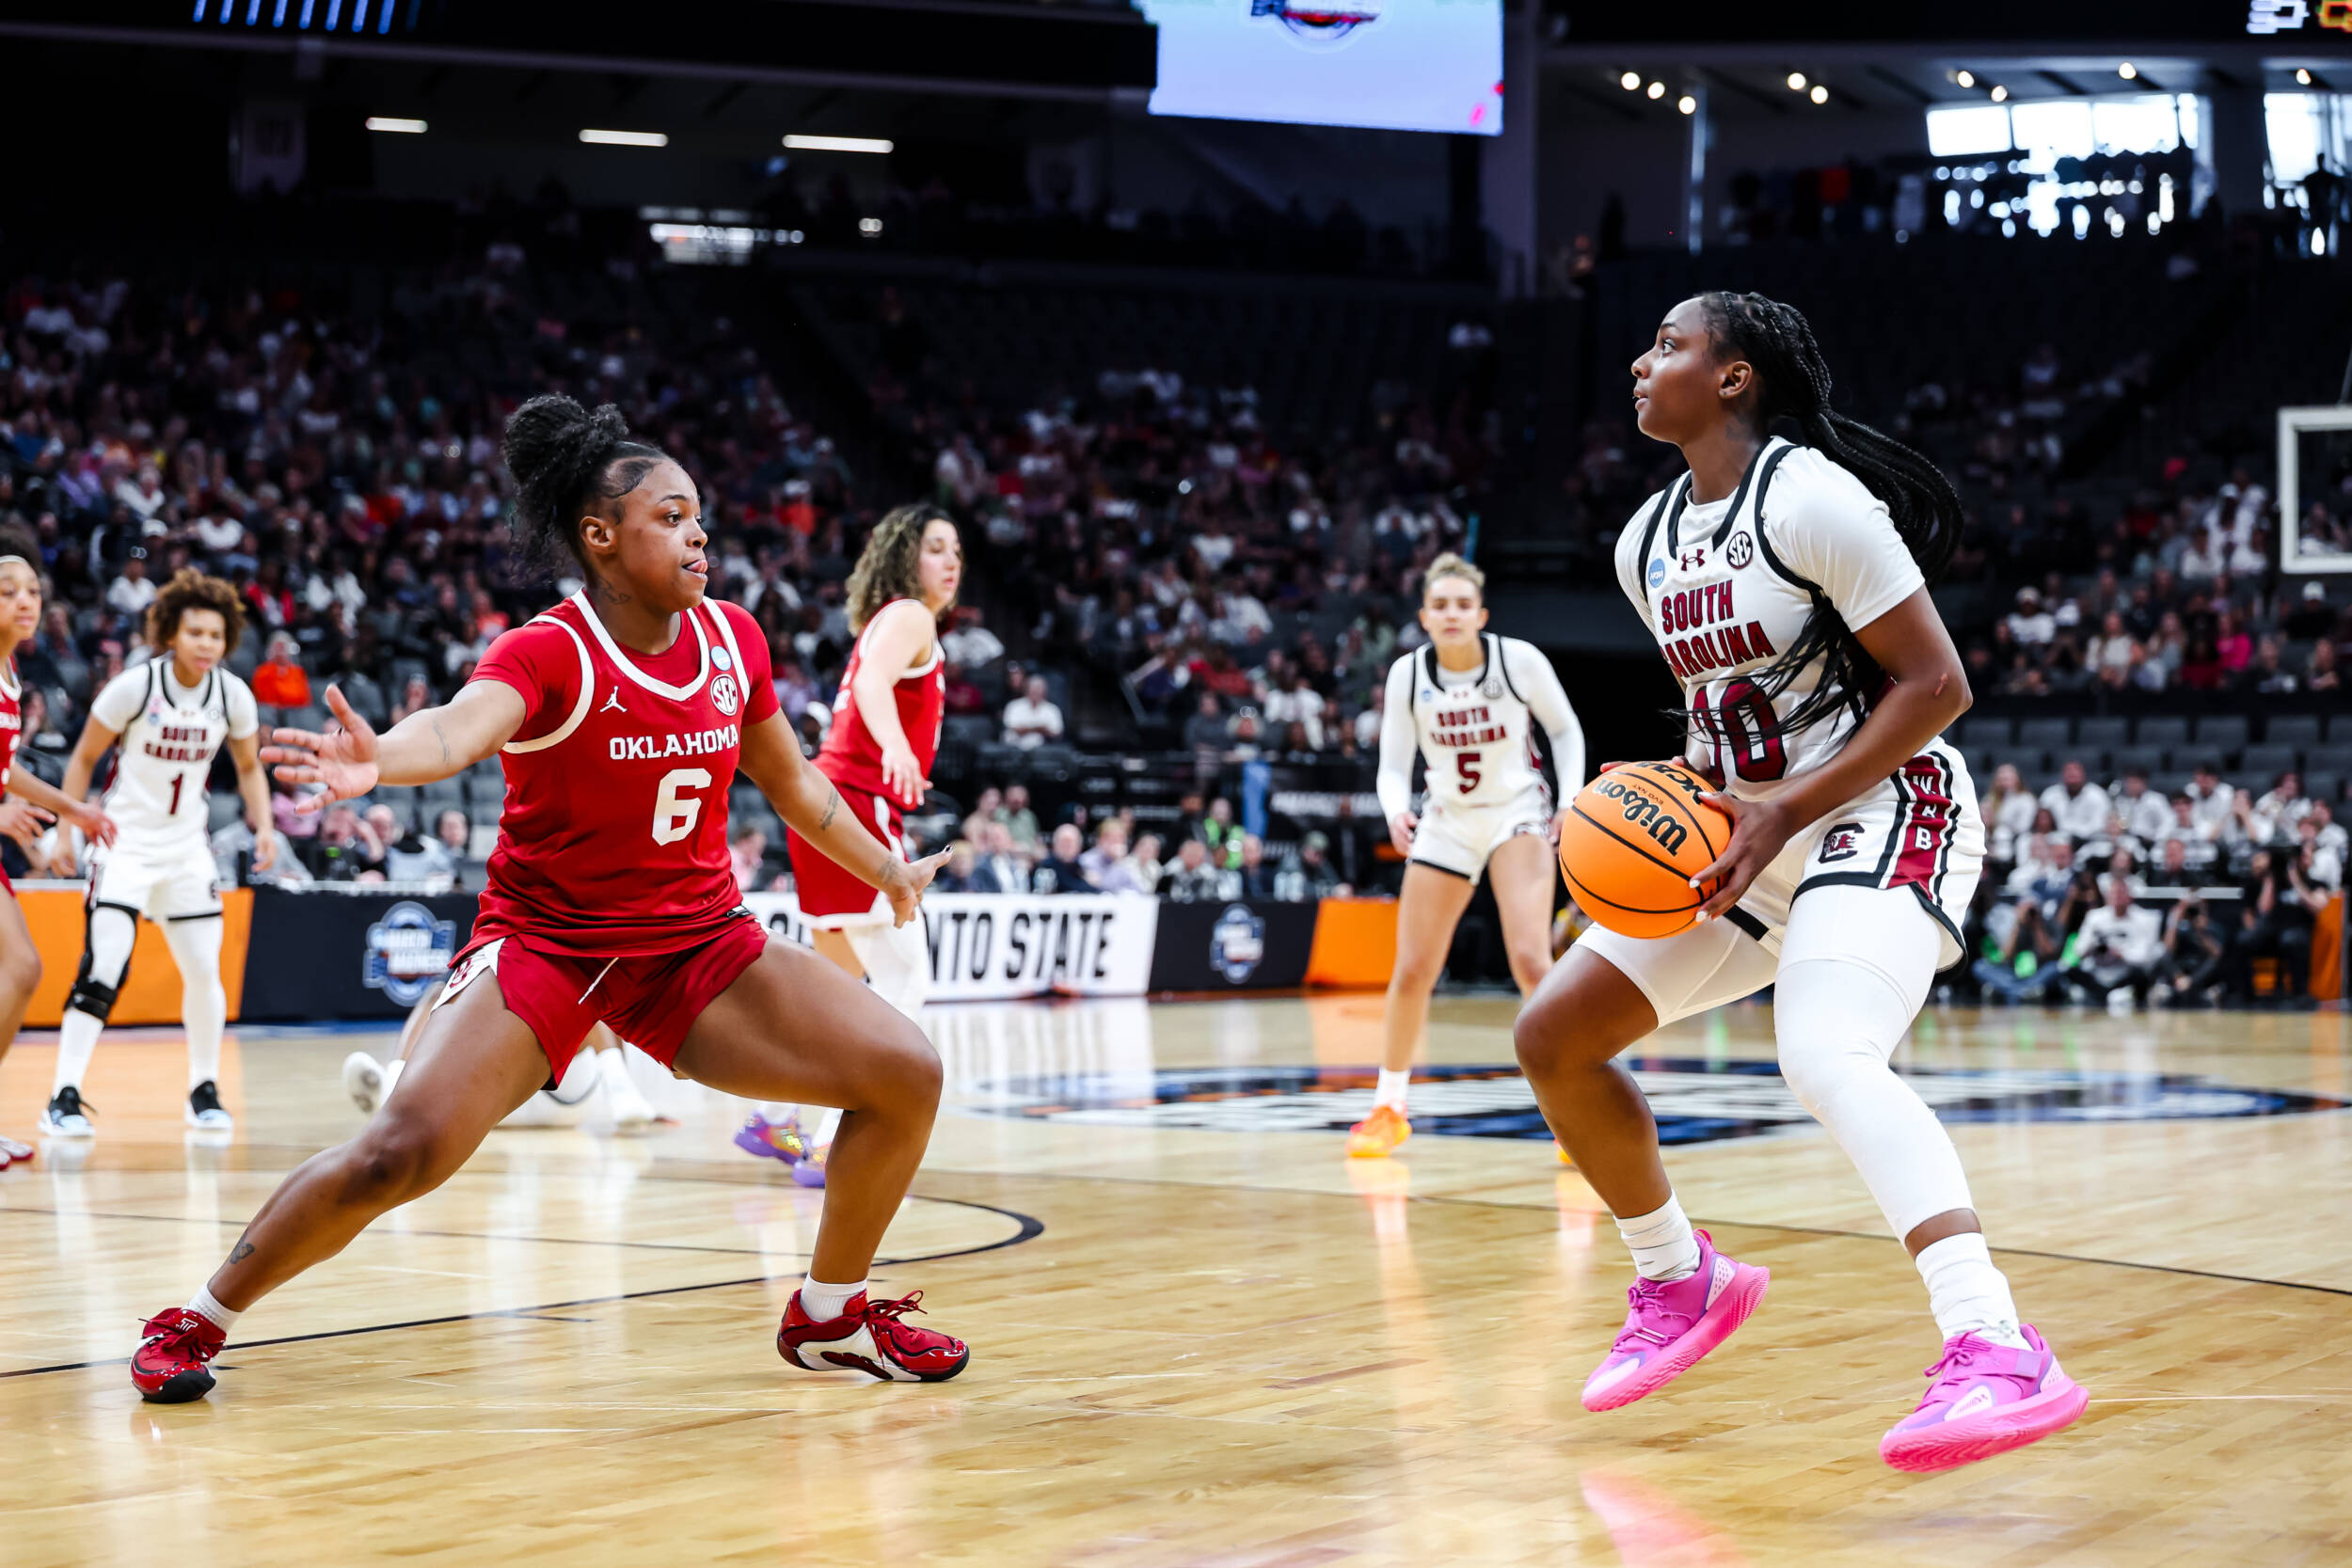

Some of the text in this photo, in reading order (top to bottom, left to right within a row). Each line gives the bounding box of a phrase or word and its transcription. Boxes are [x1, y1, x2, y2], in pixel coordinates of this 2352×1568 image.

[1727, 531, 1753, 568] SEC
[1661, 579, 1734, 635] SOUTH
[1660, 620, 1777, 677] AROLINA
[712, 676, 737, 714] SEC
[1438, 706, 1490, 727] SOUTH
[610, 723, 739, 760] OKLAHOMA
[1692, 676, 1788, 792] 10
[170, 773, 183, 816] 1
[1456, 752, 1482, 795] 5
[652, 768, 712, 847] 6
[1592, 778, 1688, 857] Wilson
[1006, 911, 1114, 978] STATE
